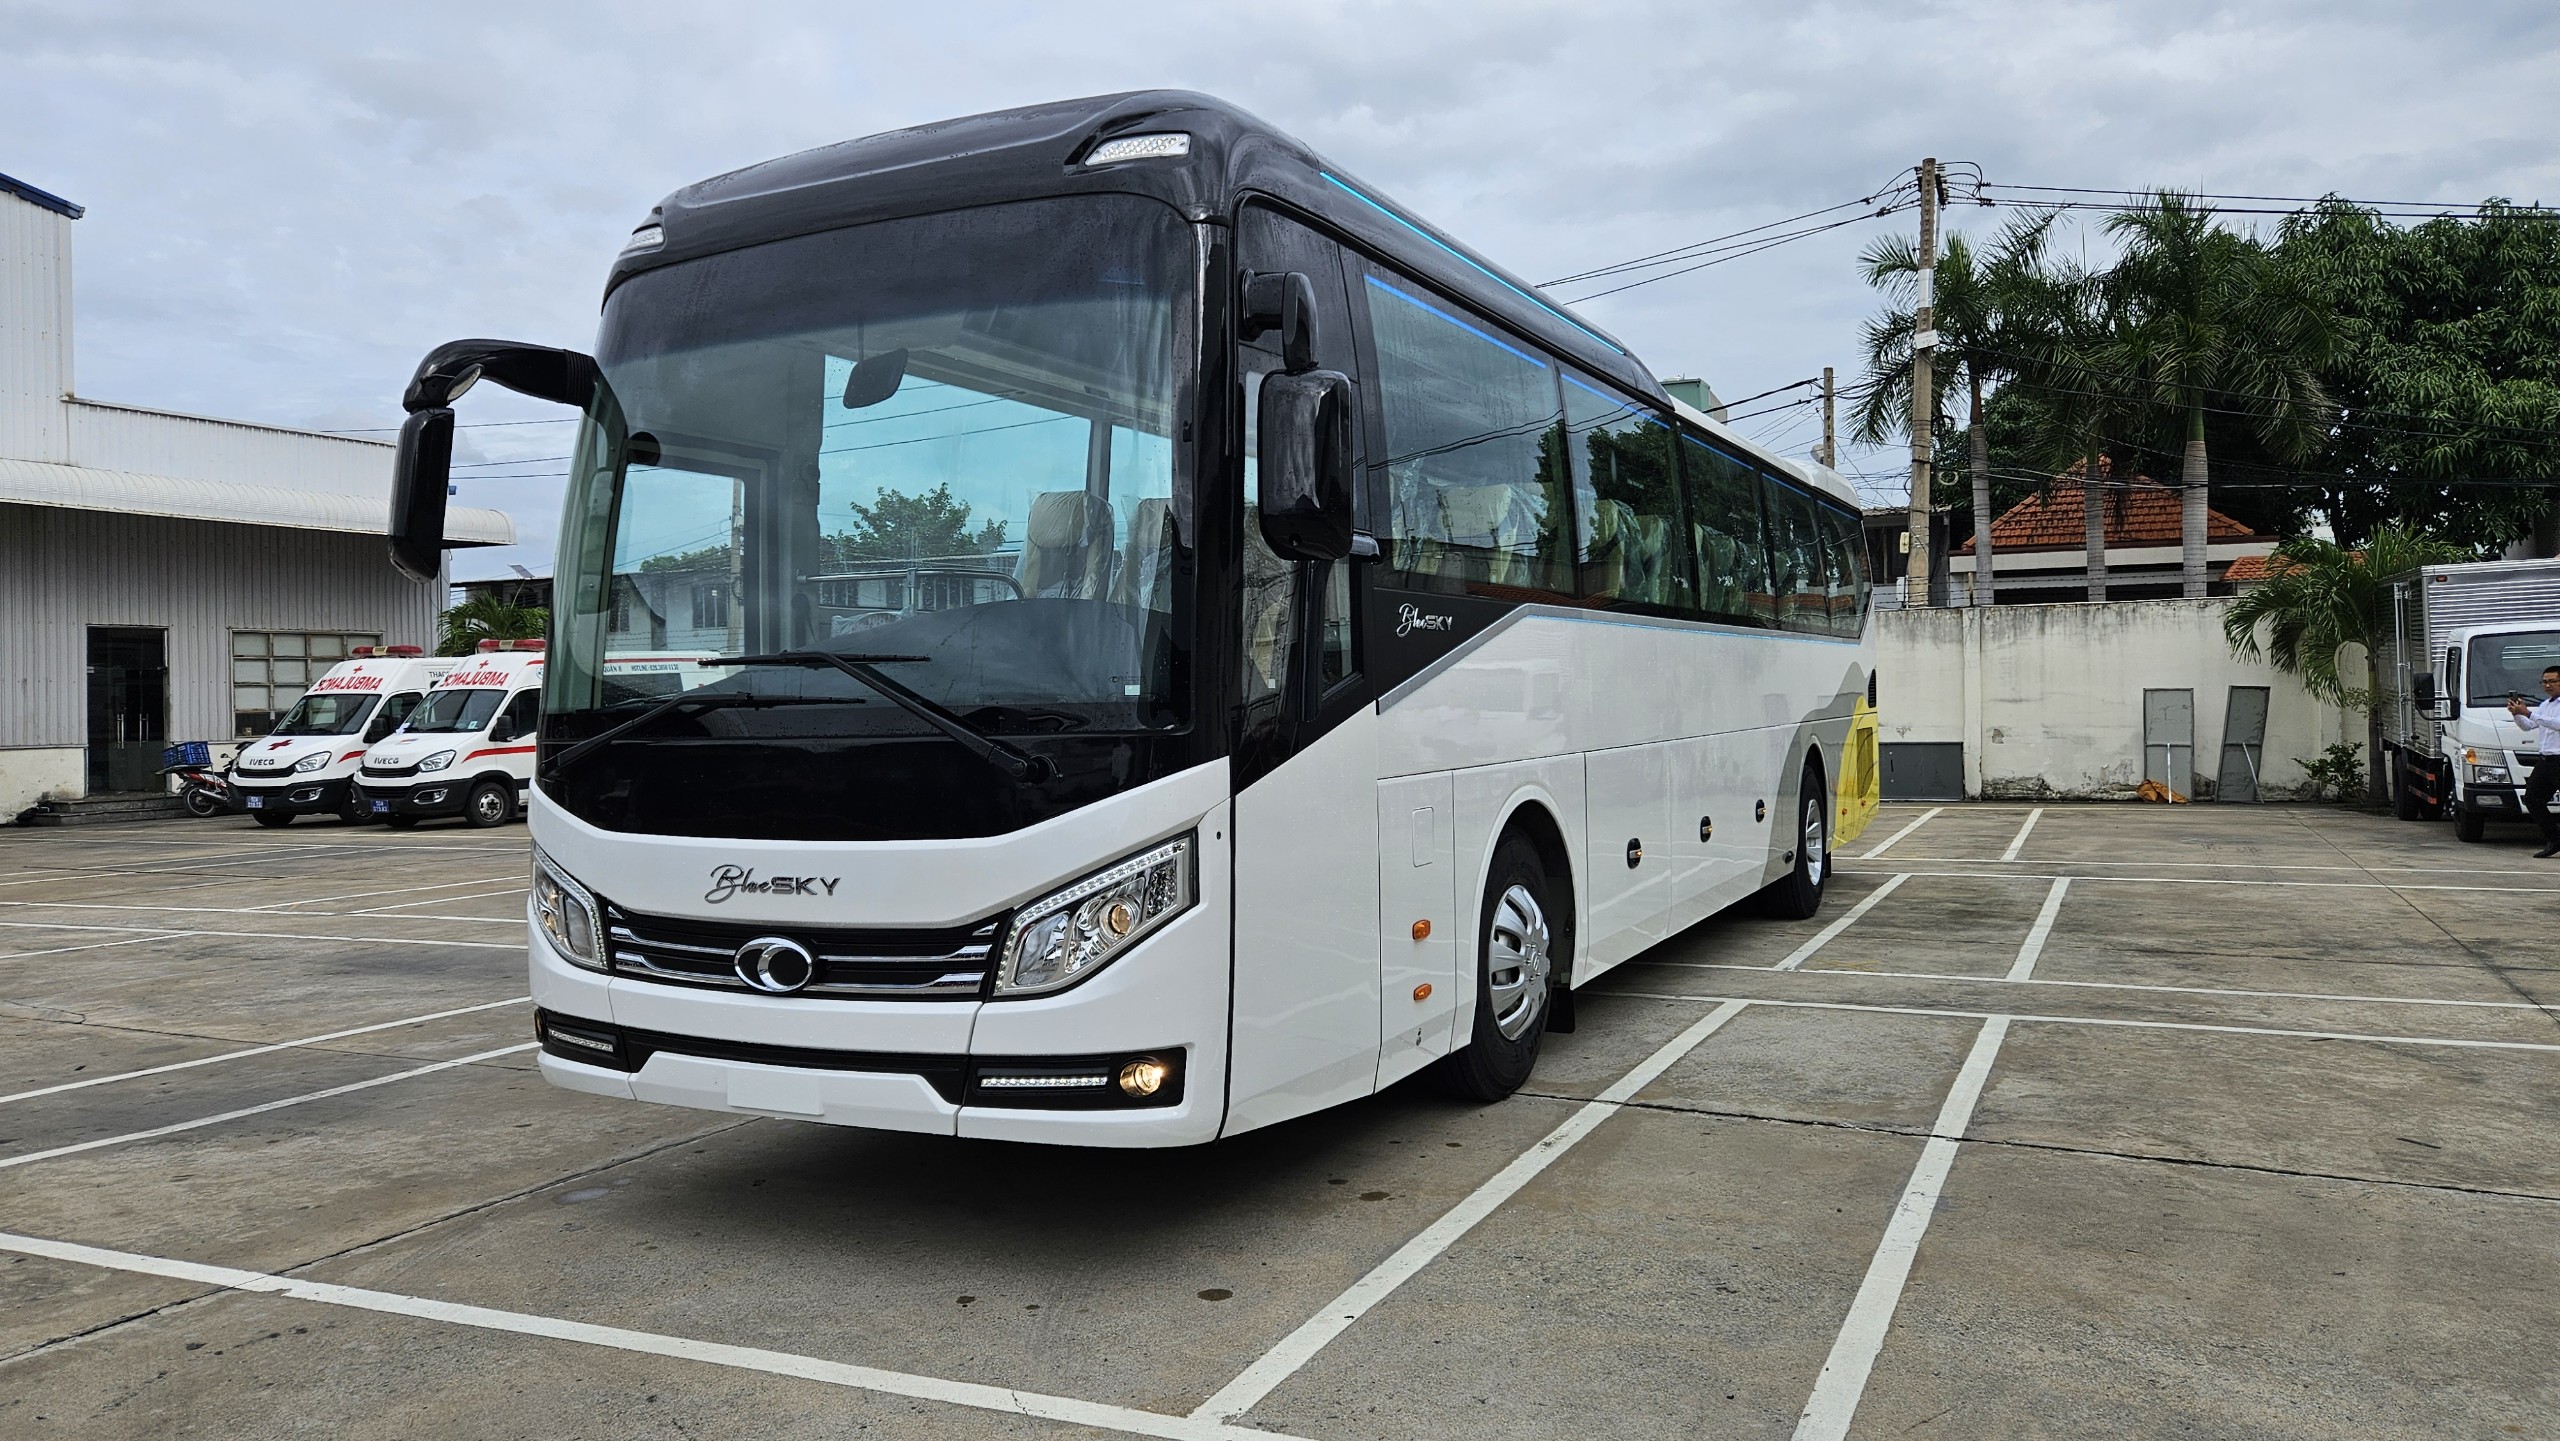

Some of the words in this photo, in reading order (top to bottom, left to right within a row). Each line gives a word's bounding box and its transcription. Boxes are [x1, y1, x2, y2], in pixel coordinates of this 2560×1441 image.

[249, 758, 275, 766] IVECO
[373, 757, 399, 765] IVECO
[704, 864, 841, 904] BlueSKY
